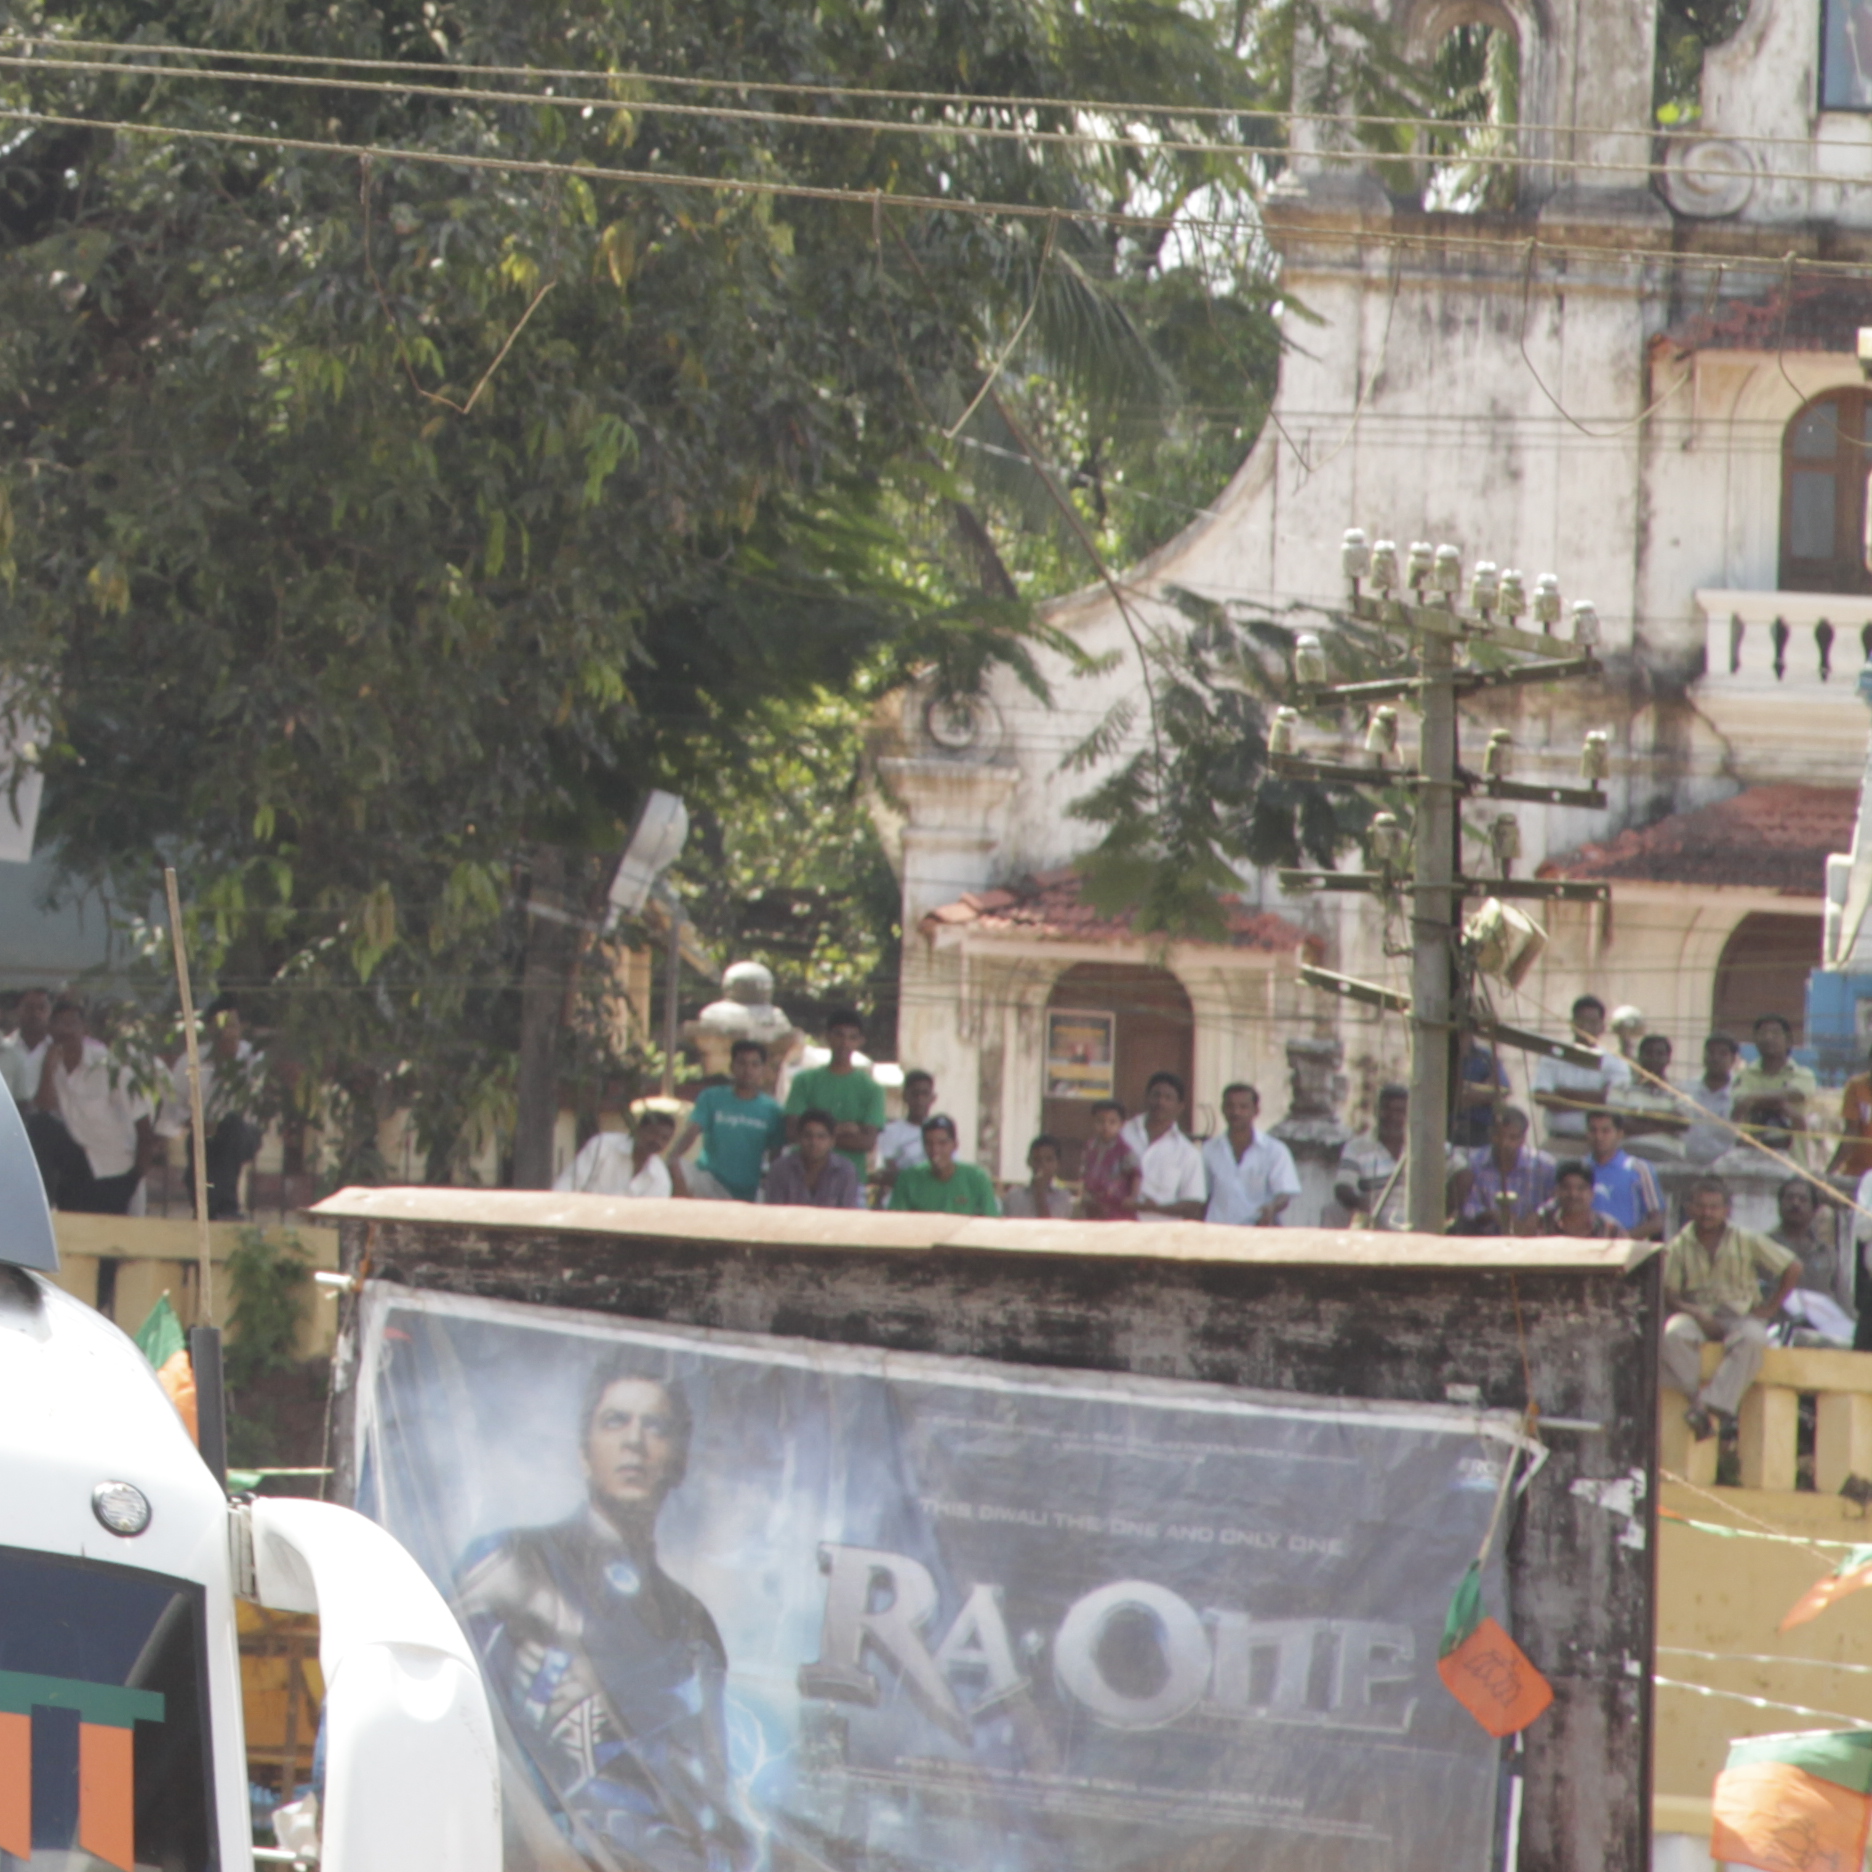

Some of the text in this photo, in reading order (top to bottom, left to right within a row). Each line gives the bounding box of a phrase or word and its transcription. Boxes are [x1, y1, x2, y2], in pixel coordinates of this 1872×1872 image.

[920, 1499, 1346, 1557] THIS DIWALI THE ONE AND ONLY ONE
